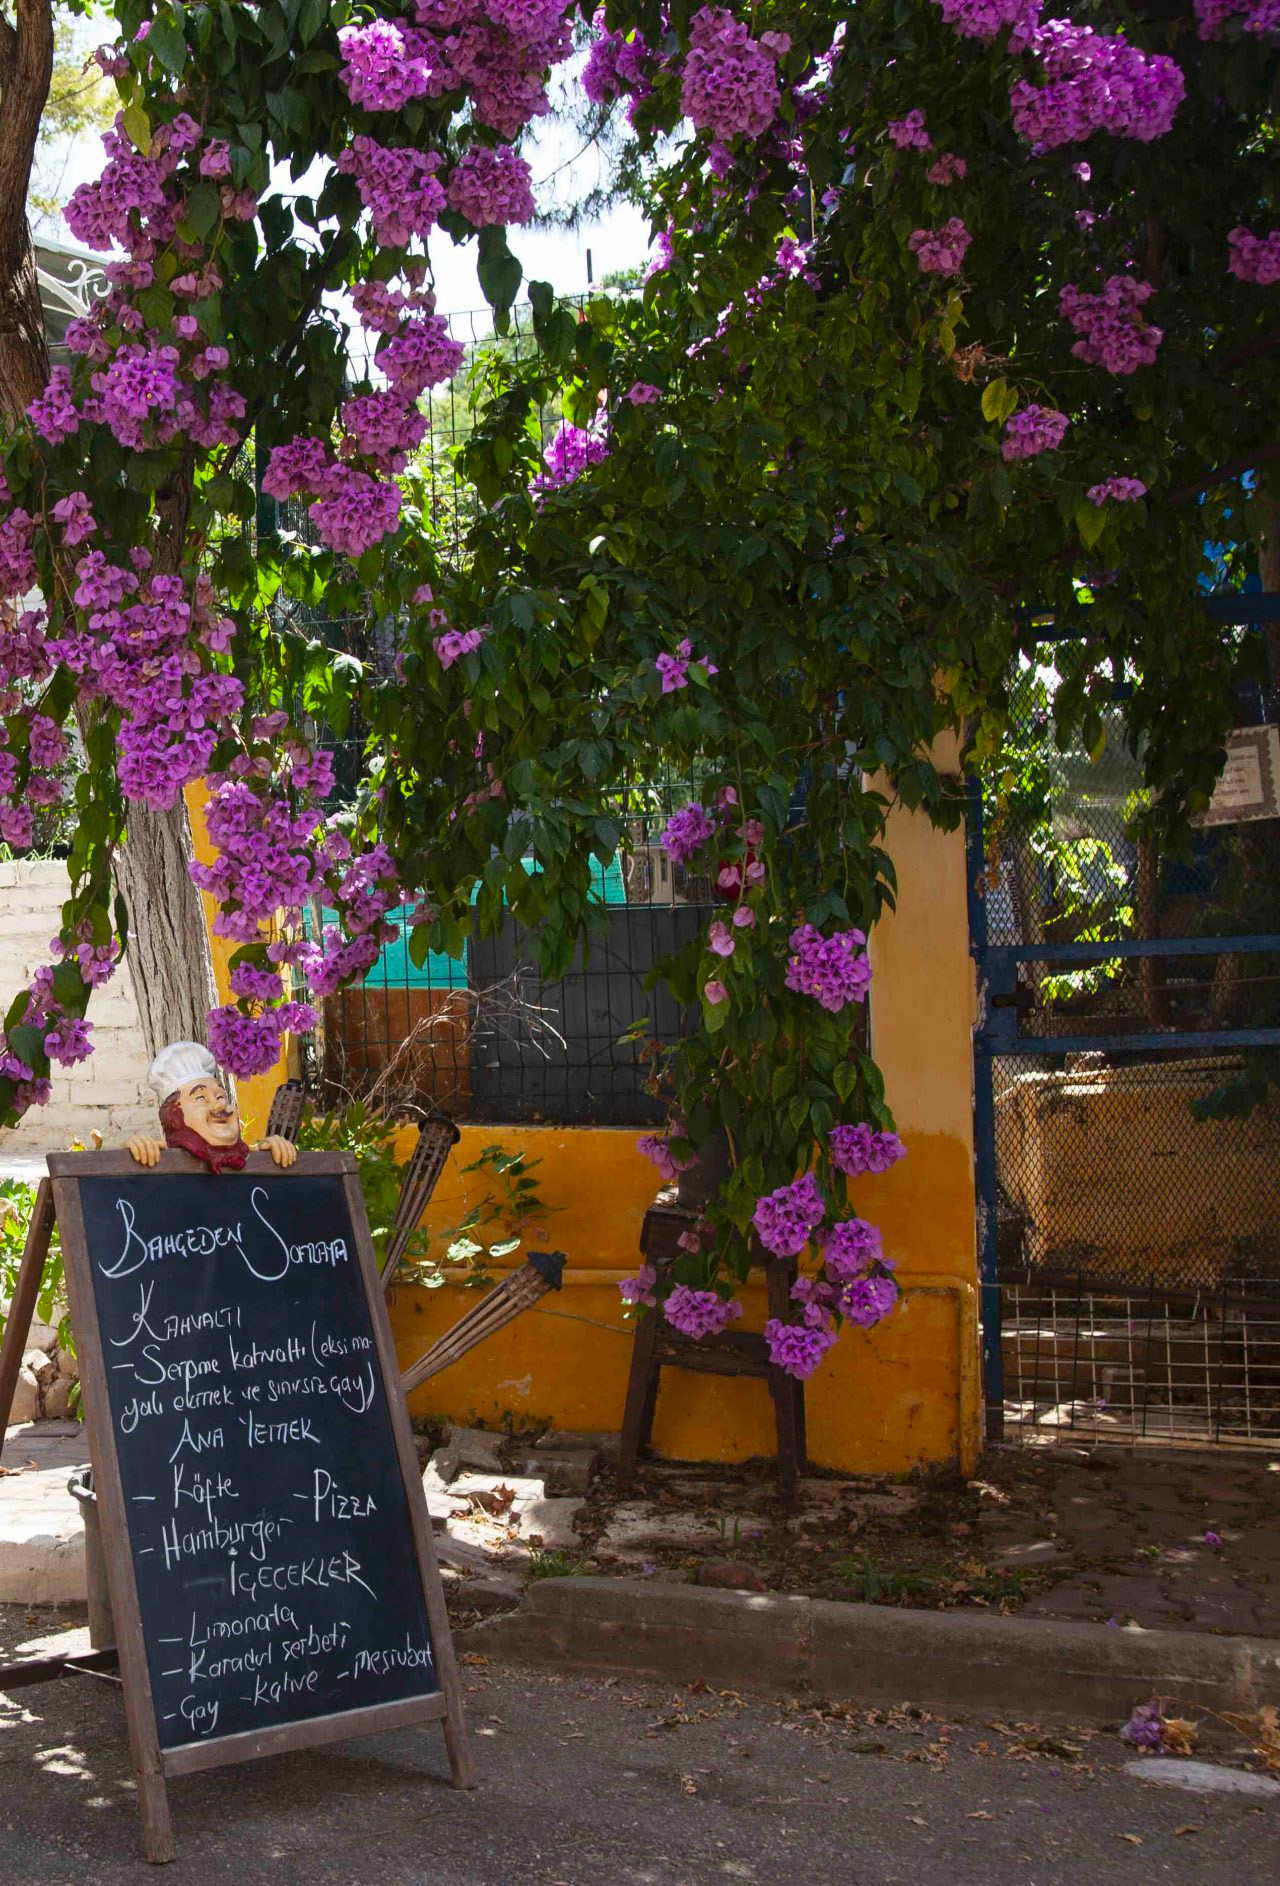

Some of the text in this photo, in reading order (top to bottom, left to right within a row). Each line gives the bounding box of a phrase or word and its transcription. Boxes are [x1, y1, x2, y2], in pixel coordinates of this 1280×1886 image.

[174, 1463, 239, 1522] Köfte
[162, 1517, 294, 1571] Hamburger
[190, 1603, 299, 1647] Limonata
